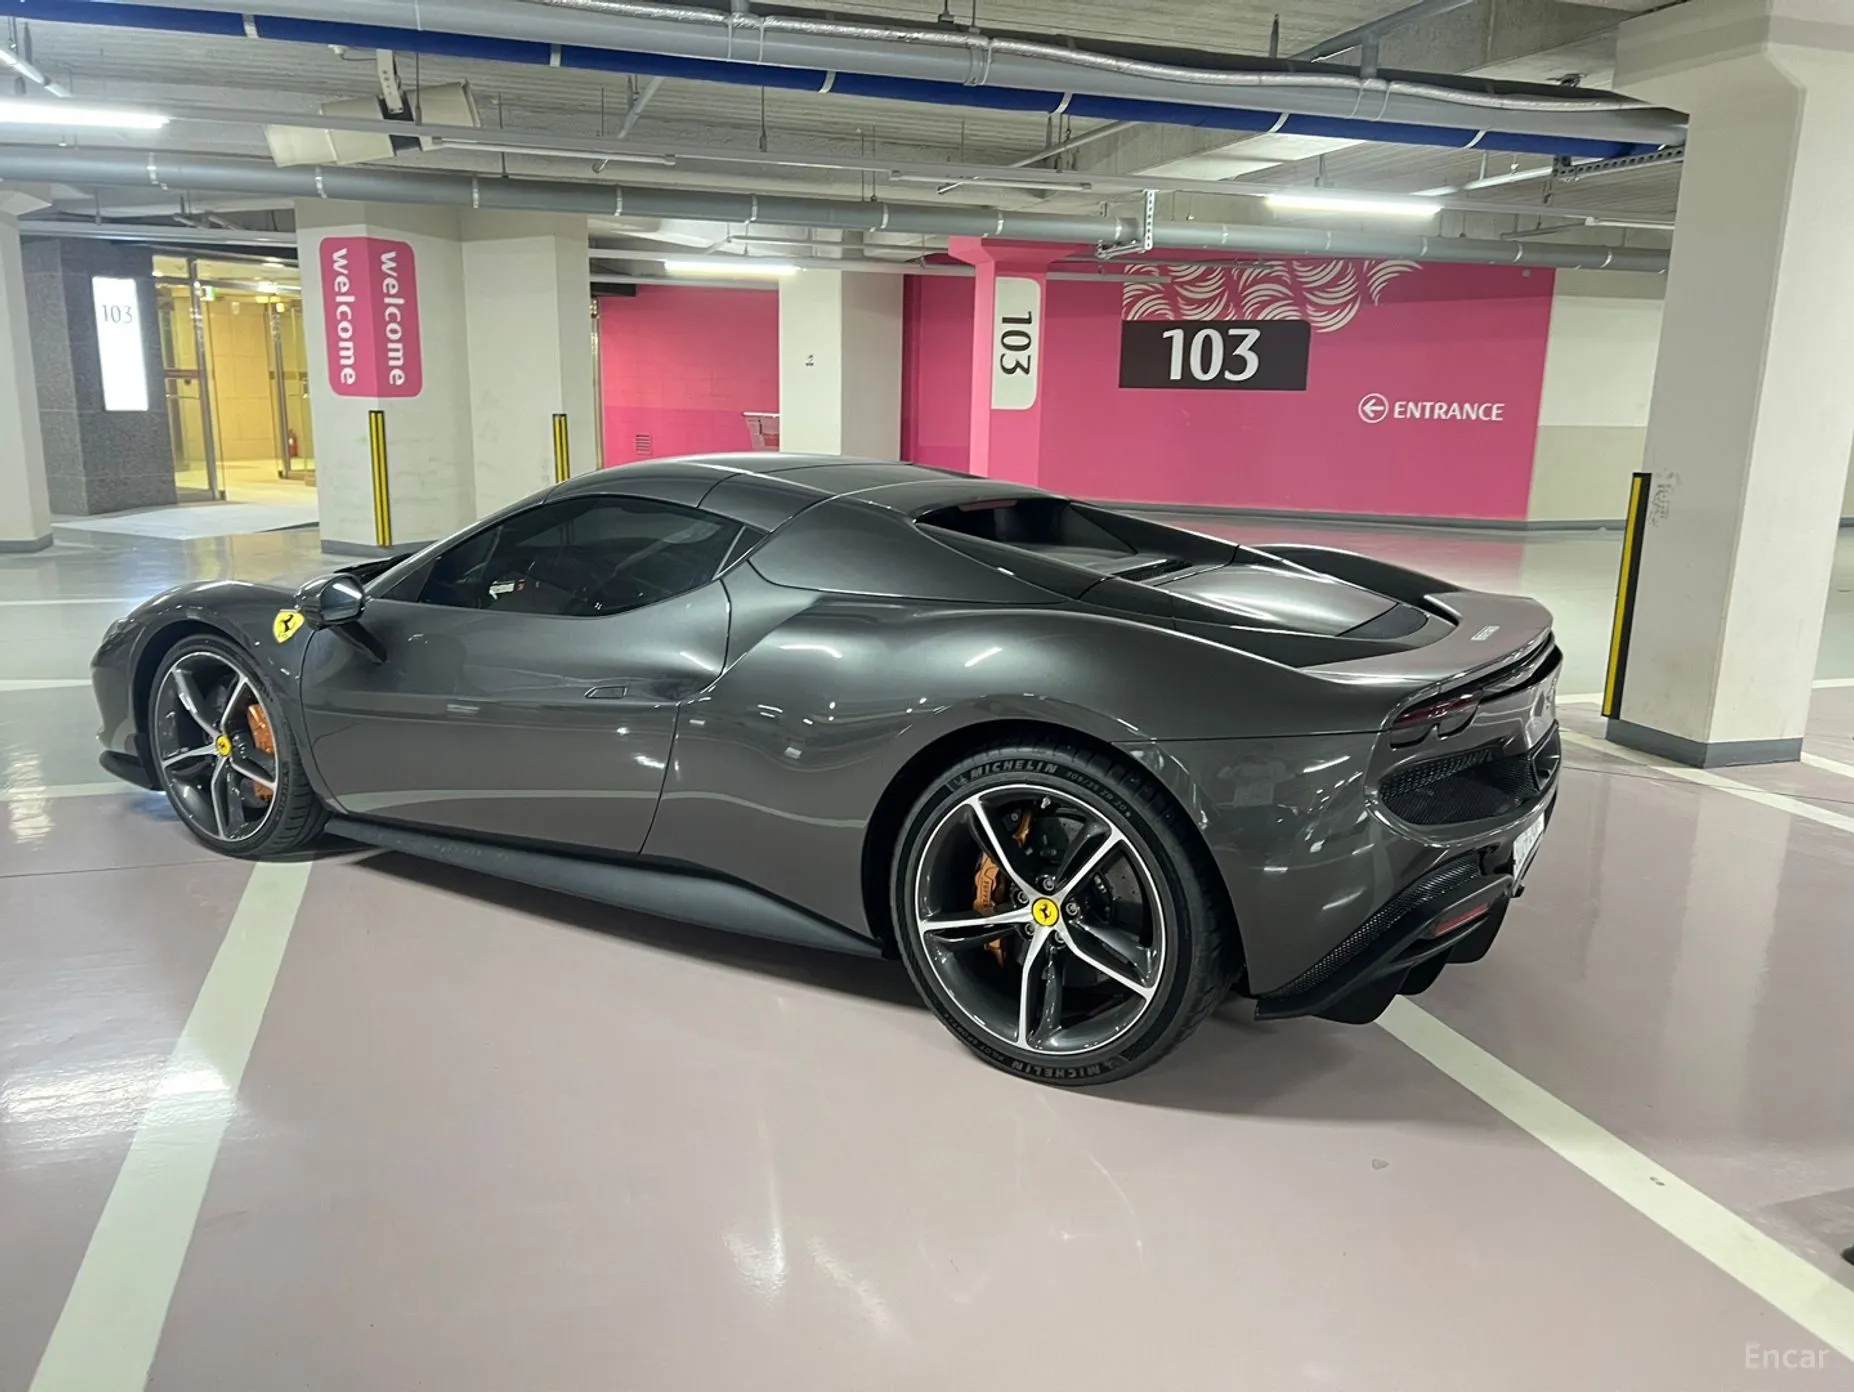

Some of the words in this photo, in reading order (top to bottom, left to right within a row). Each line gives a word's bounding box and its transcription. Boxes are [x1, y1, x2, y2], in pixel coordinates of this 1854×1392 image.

[102, 304, 133, 324] 103
[332, 248, 356, 385] welcome
[380, 251, 406, 386] welcome
[1000, 310, 1033, 375] 103
[1162, 328, 1261, 382] 103
[1393, 401, 1505, 421] ENTRANCE
[970, 759, 1058, 779] MICHELIN
[1011, 1060, 1101, 1079] MICHELIN
